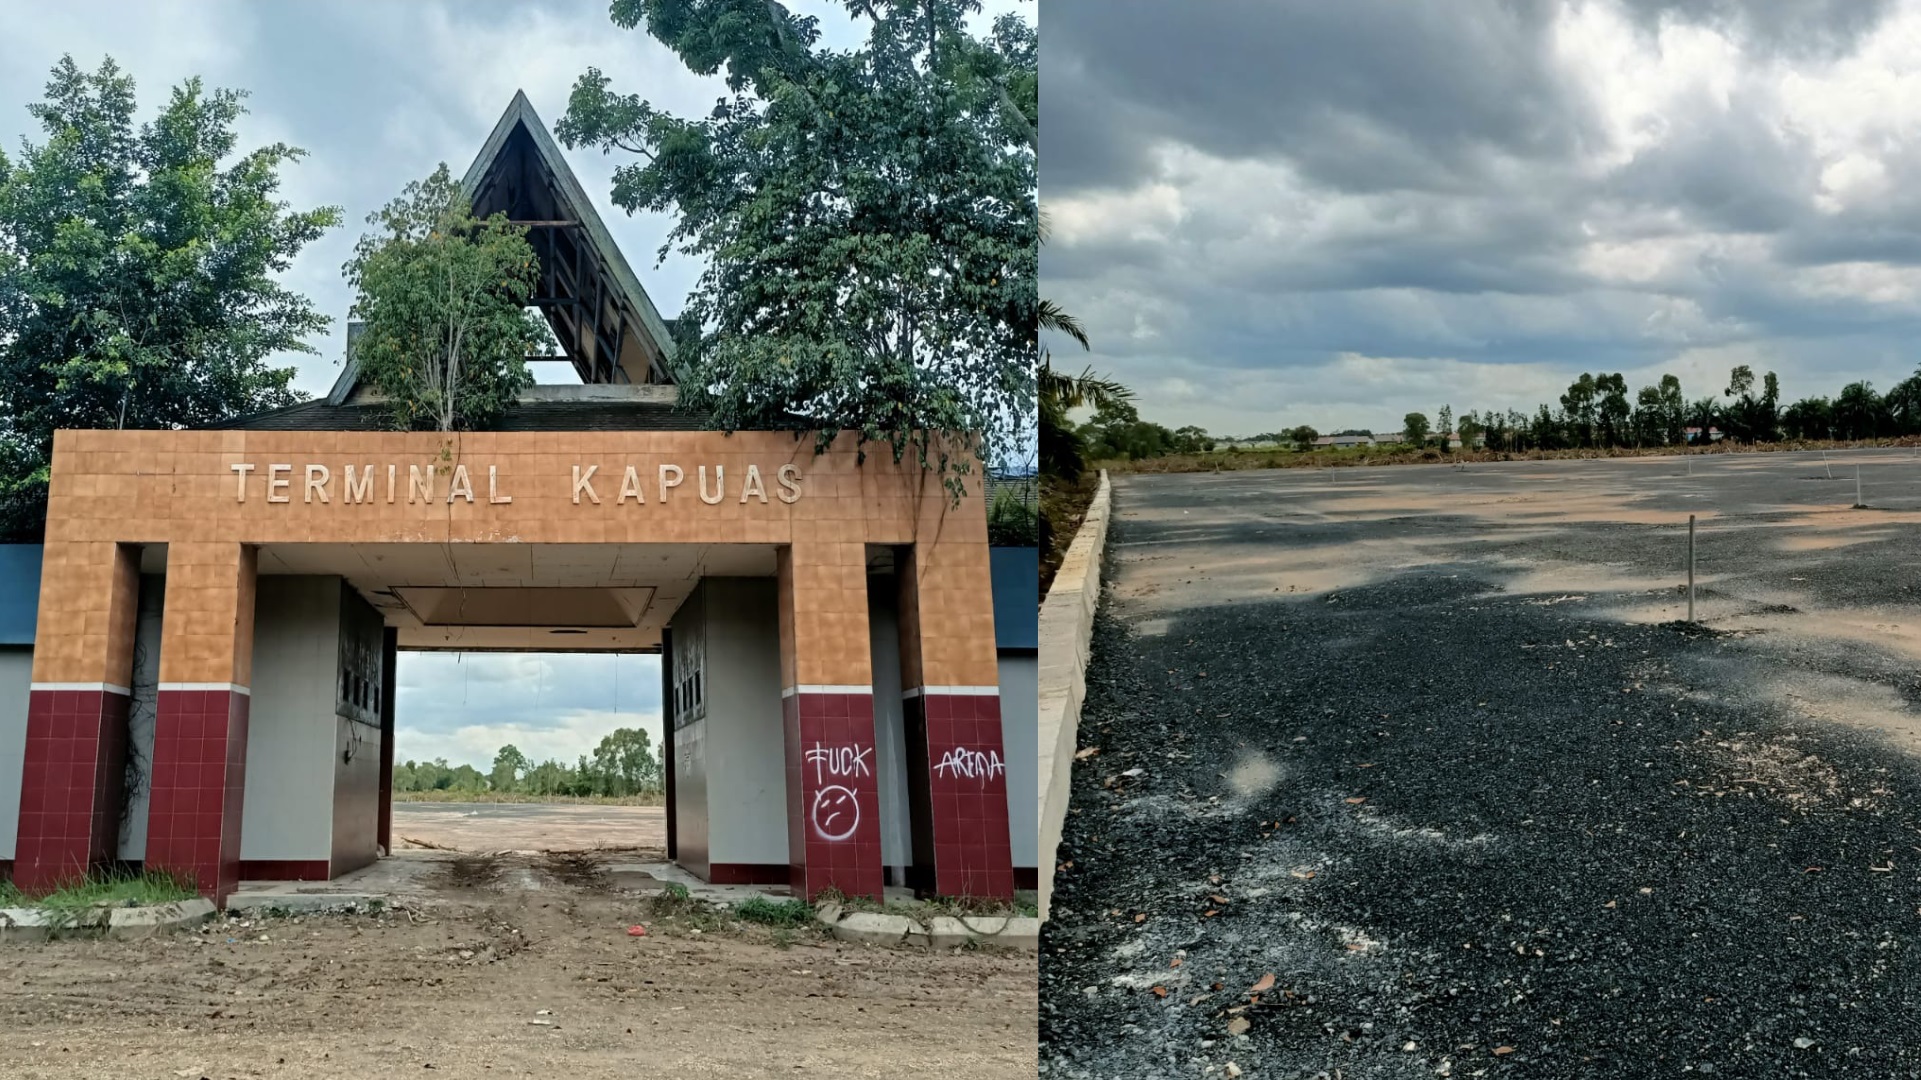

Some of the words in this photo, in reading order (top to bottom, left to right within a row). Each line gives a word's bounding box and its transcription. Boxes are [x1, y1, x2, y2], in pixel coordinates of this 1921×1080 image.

[231, 464, 512, 504] TERMINAL
[571, 464, 803, 504] KAPUAS
[805, 741, 872, 785] FUCK
